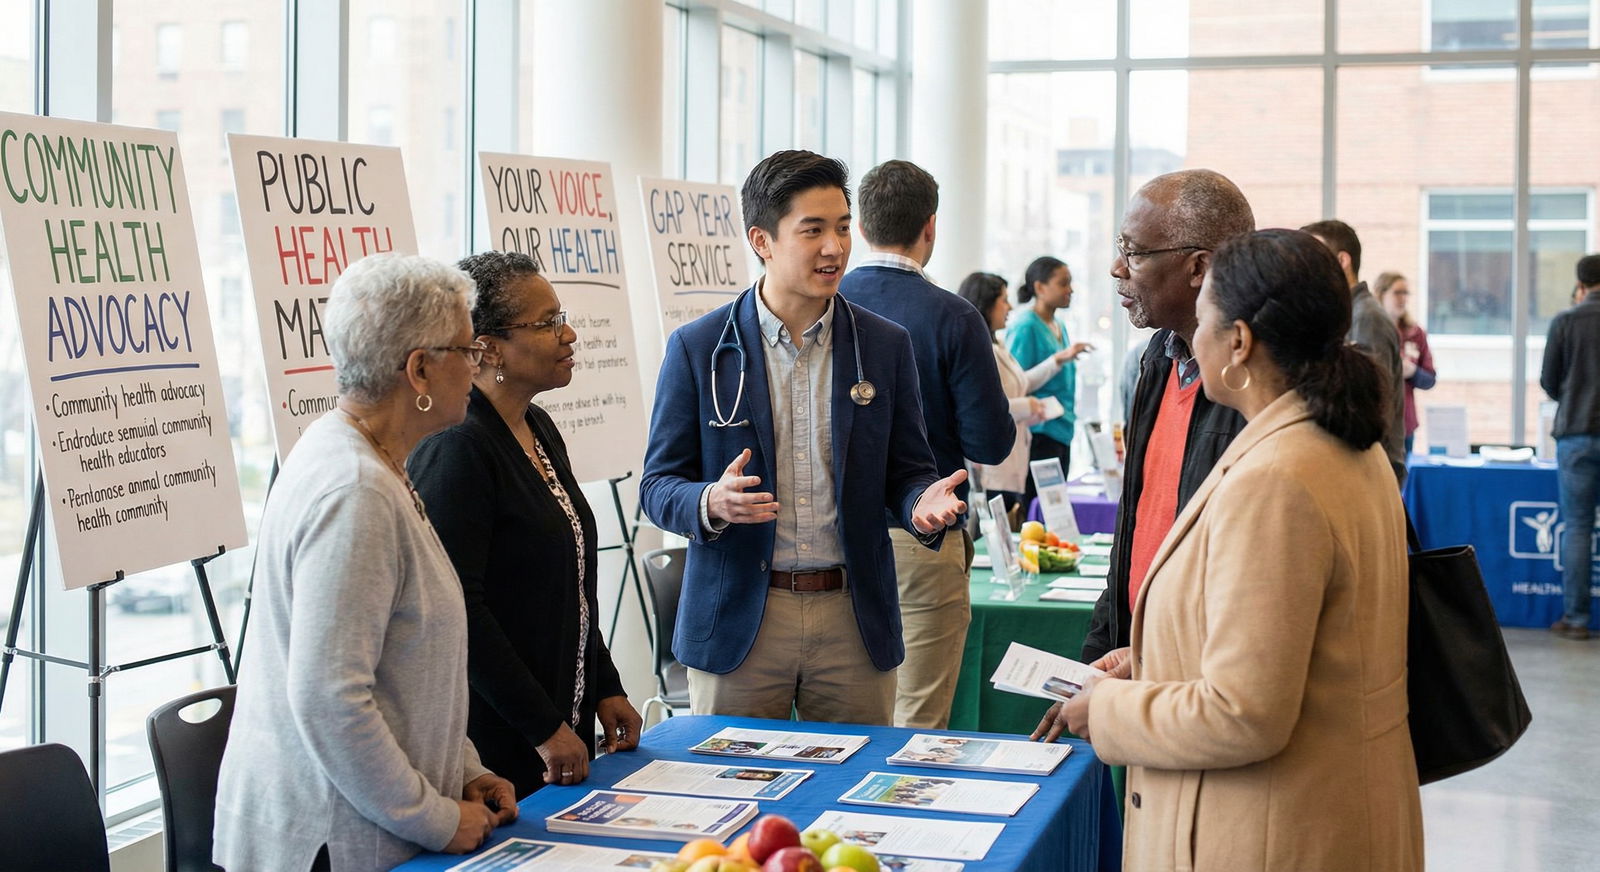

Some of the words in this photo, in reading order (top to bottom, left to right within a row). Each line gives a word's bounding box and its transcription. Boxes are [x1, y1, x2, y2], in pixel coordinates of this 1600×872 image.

[1, 129, 177, 214] COMMUNITY
[257, 150, 375, 216] PUBLIC
[488, 165, 548, 214] YOUR
[549, 170, 613, 222] VOICE,
[650, 188, 685, 234] GAP
[688, 191, 737, 238] YEAR
[45, 219, 170, 284] HEALTH
[549, 228, 619, 274] HEALTH
[667, 241, 737, 286] SERVICE
[48, 290, 192, 362] ADVOCACY
[52, 386, 119, 419] Community
[121, 381, 157, 408] health
[161, 380, 206, 406] advocacy
[57, 426, 115, 453] Endroduce
[161, 410, 213, 436] community
[79, 448, 115, 473] health
[118, 442, 167, 465] educators
[128, 470, 161, 495] animal
[163, 458, 217, 488] community
[76, 507, 112, 533] health
[115, 494, 169, 522] community
